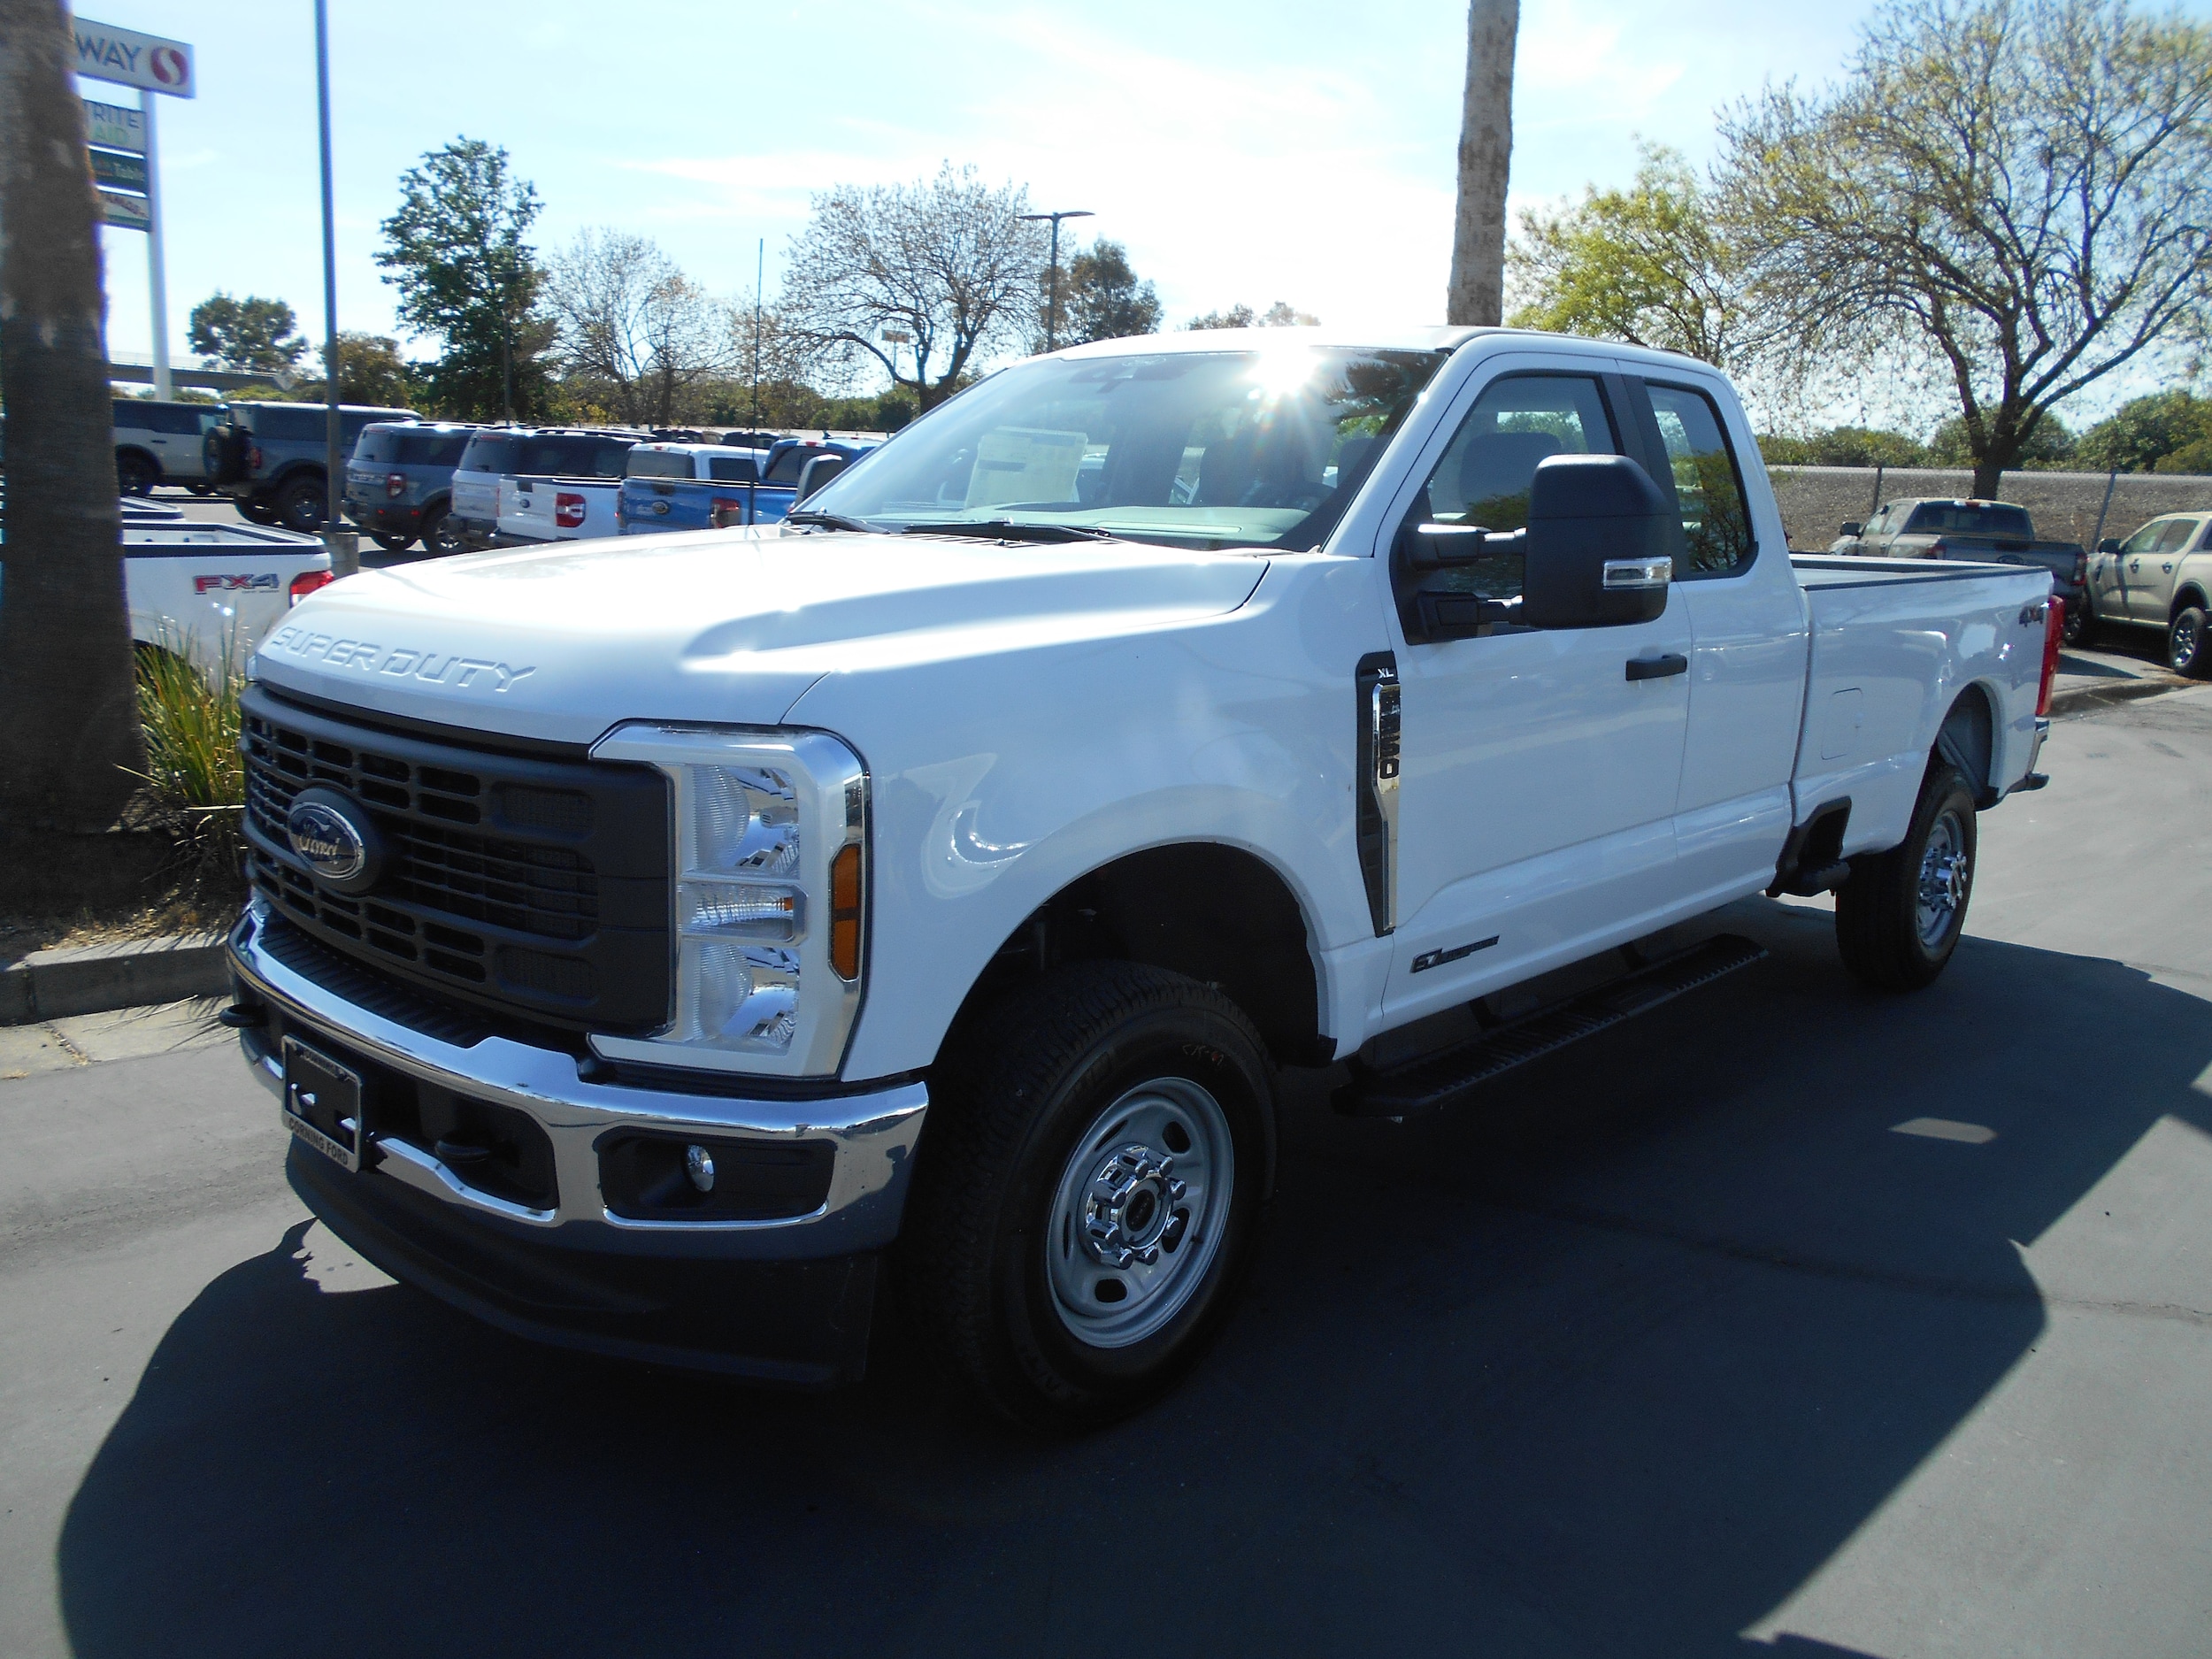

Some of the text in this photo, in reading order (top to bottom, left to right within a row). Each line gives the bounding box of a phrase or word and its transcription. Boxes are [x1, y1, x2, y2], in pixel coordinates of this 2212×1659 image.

[93, 104, 142, 129] RITE
[93, 124, 130, 147] AID
[193, 573, 280, 595] FX4
[271, 626, 537, 693] SUPER DUTY
[1377, 667, 1394, 680] XL
[298, 816, 342, 856] Ford
[288, 1117, 349, 1165] CORNING FORD
